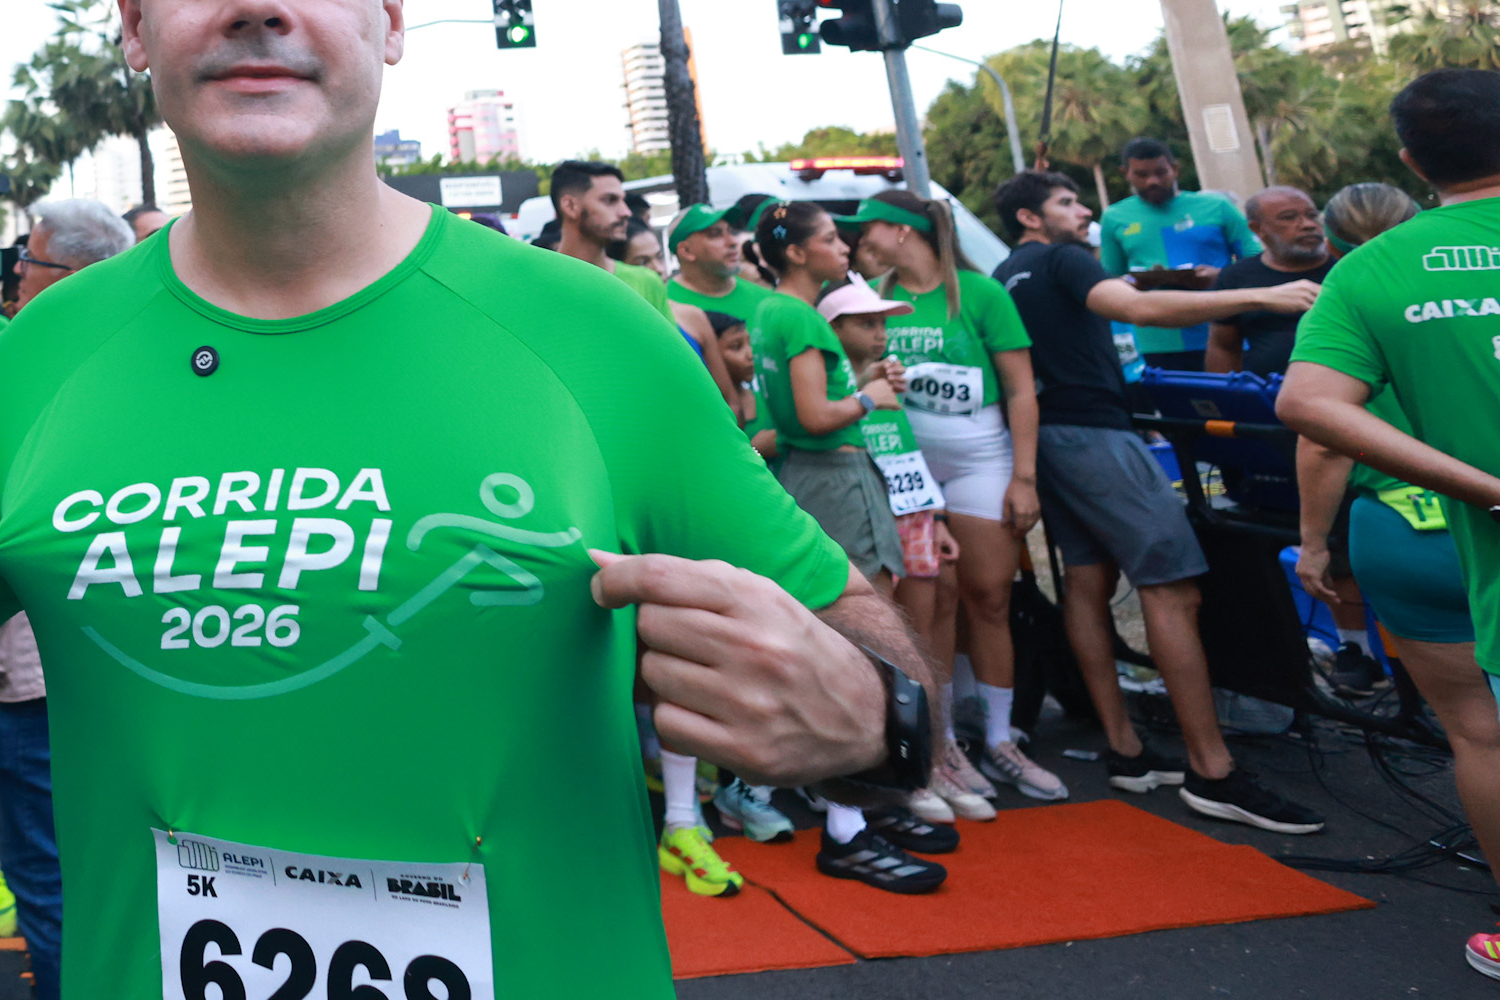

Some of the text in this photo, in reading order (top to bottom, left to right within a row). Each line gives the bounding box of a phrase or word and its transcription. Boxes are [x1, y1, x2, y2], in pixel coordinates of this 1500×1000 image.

[1404, 297, 1500, 323] CAIXA
[888, 335, 945, 354] ALEPI
[909, 376, 970, 402] 6093
[52, 467, 392, 533] CORRIDA
[67, 518, 393, 600] ALEPI
[160, 604, 301, 650] 2026
[222, 852, 265, 869] ALEPI
[285, 866, 362, 889] CAIXA
[186, 874, 218, 898] 5K
[386, 877, 462, 903] BRASIL
